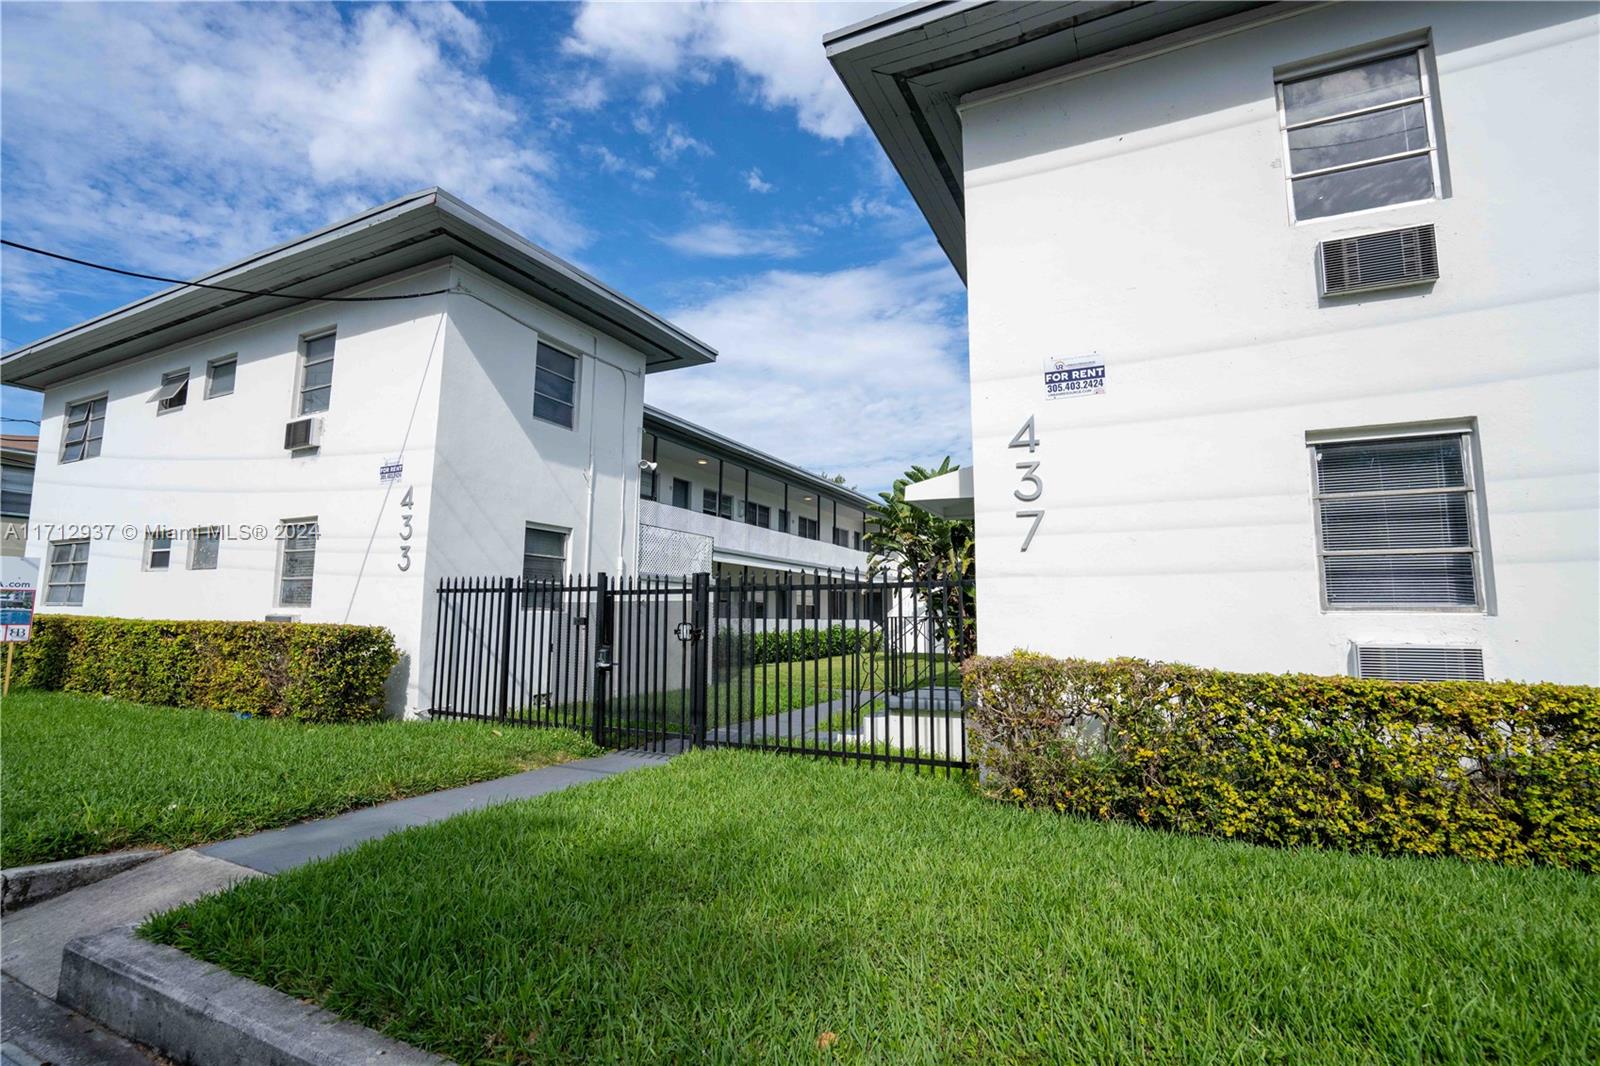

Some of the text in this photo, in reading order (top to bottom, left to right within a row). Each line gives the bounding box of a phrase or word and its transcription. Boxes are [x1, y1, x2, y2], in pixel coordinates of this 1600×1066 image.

[1046, 367, 1104, 383] FOR RENT
[1047, 379, 1104, 393] 305.403.2424
[390, 464, 402, 472] RENT
[1008, 414, 1045, 552] 437
[397, 485, 414, 572] 433
